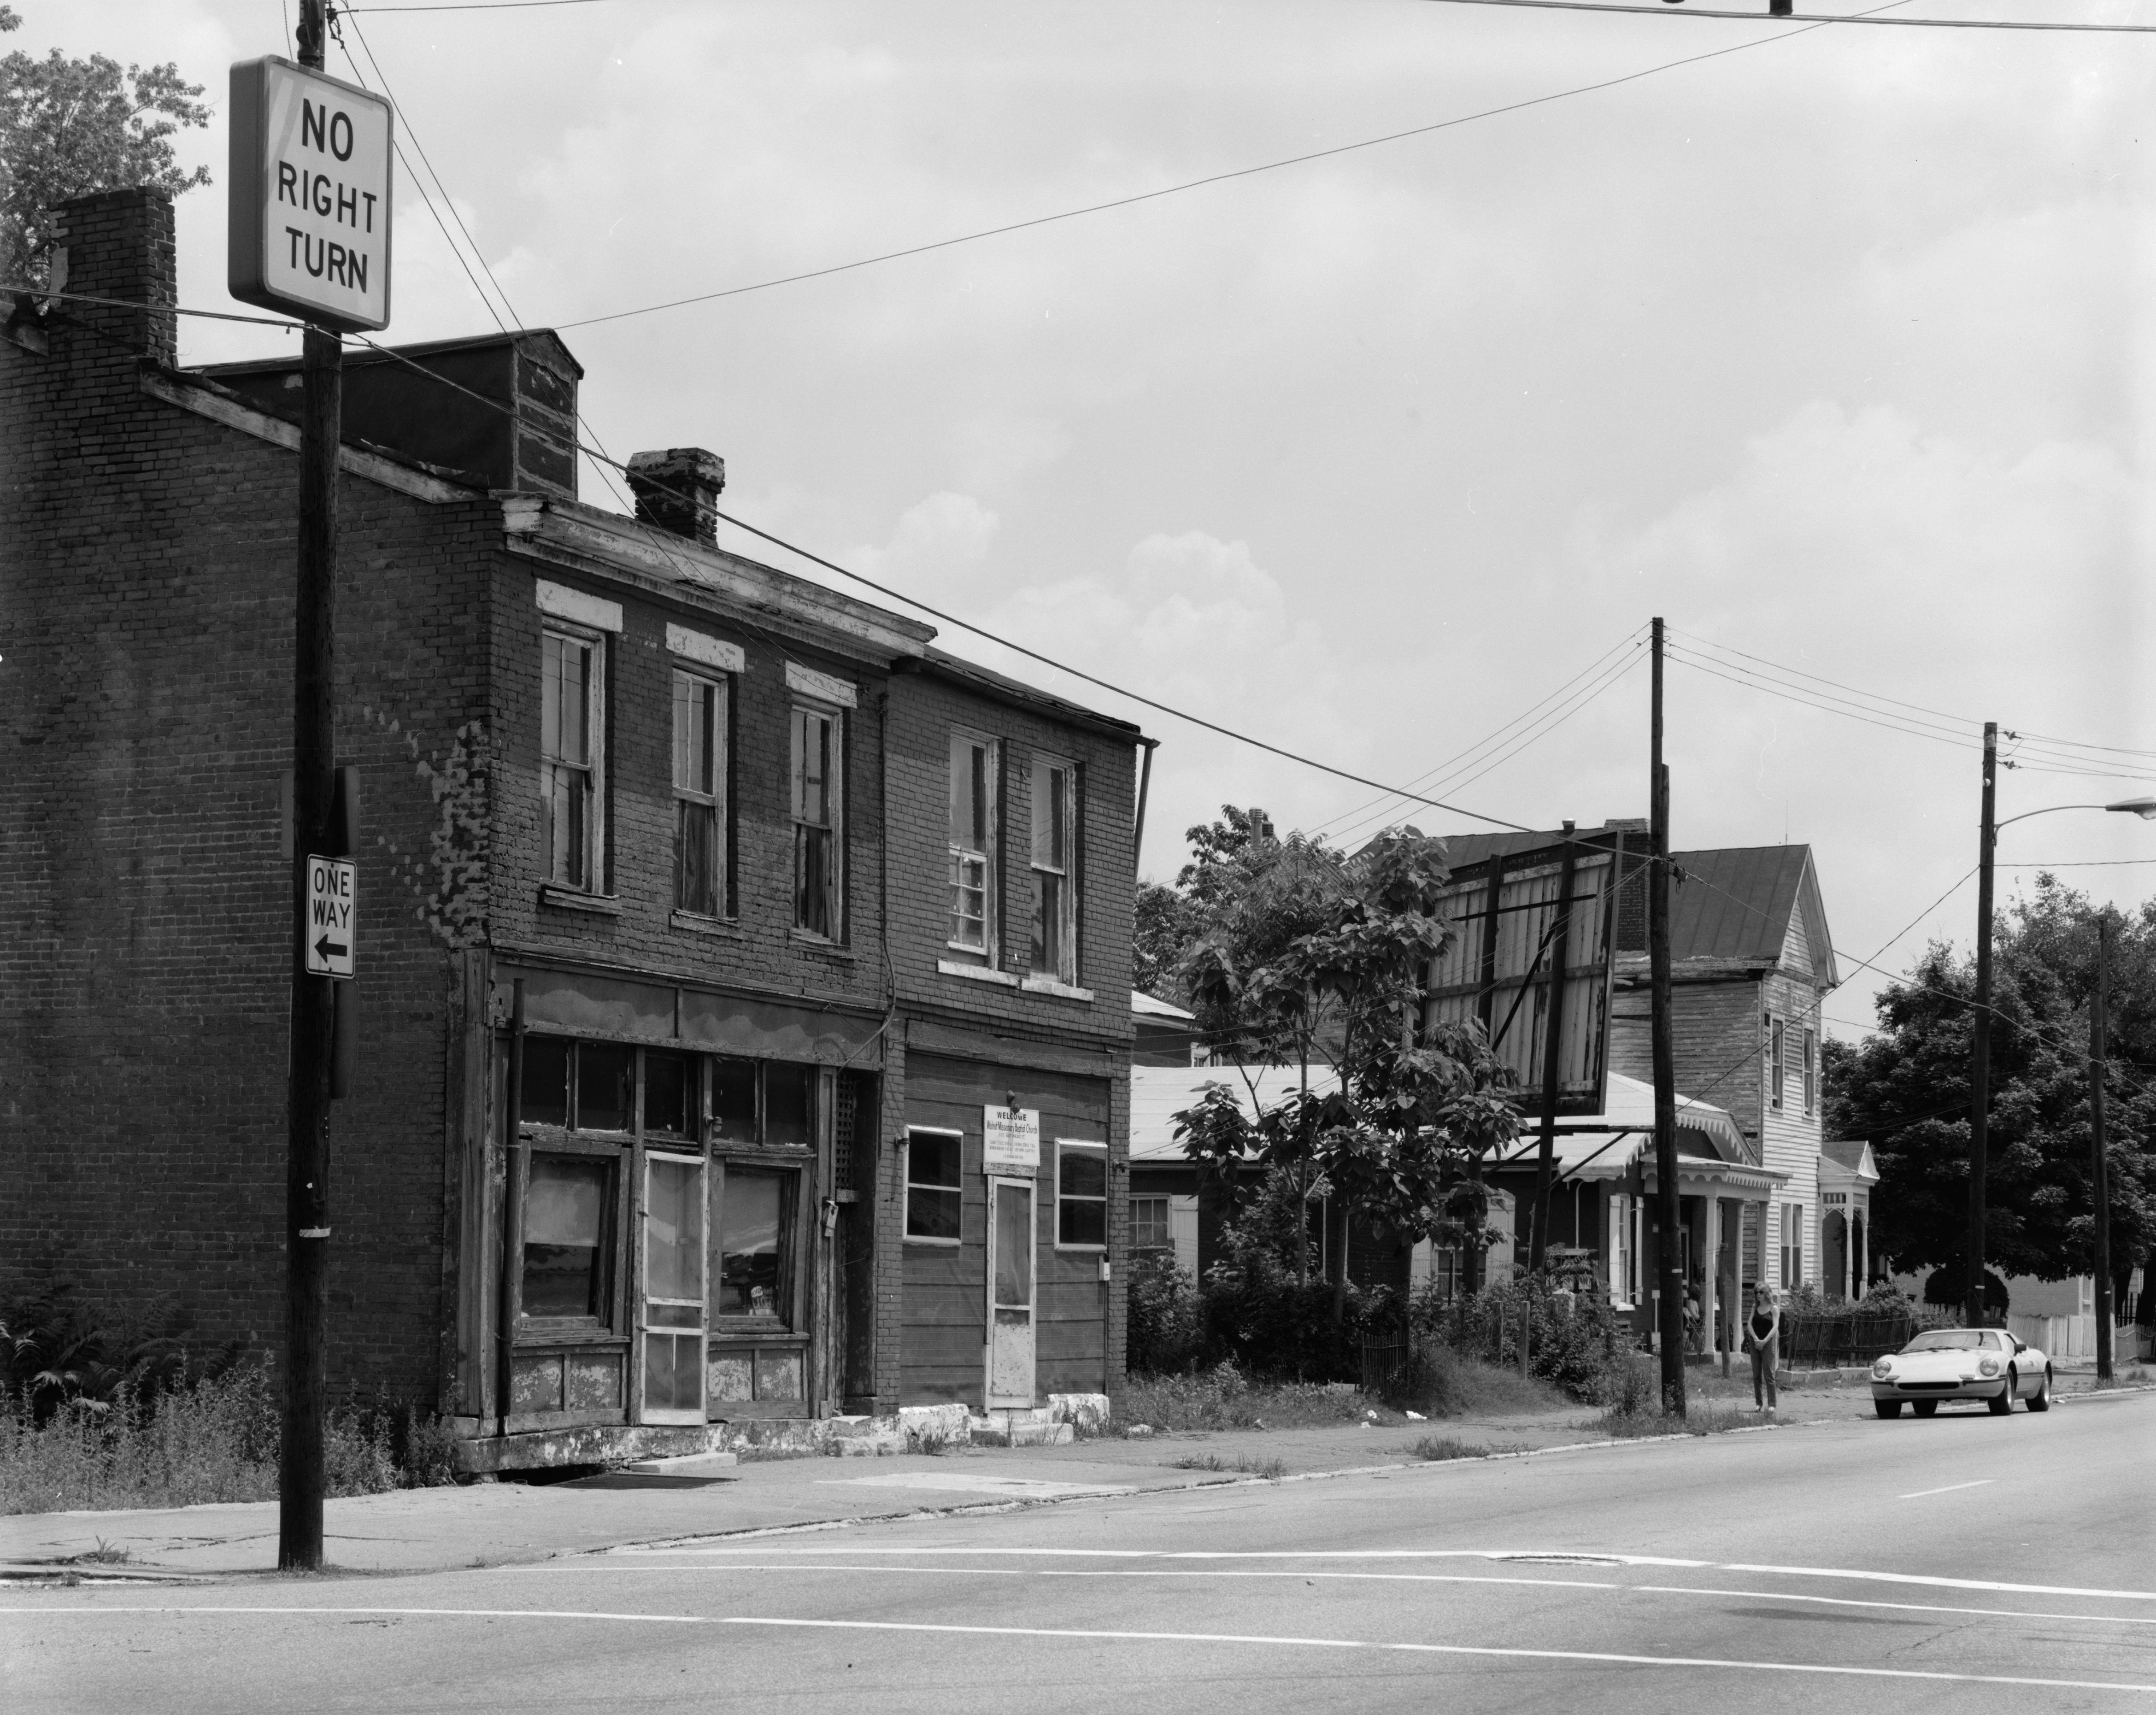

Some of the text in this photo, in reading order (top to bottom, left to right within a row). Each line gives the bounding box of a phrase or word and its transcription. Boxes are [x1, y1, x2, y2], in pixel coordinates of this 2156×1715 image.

[302, 98, 353, 162] NO
[278, 160, 377, 234] RIGHT
[286, 226, 367, 294] TURN
[315, 867, 350, 897] ONE
[313, 899, 351, 929] WAY
[987, 1120, 1038, 1134] Walnut Missionary Baptist Church
[997, 1111, 1027, 1121] WELCOME
